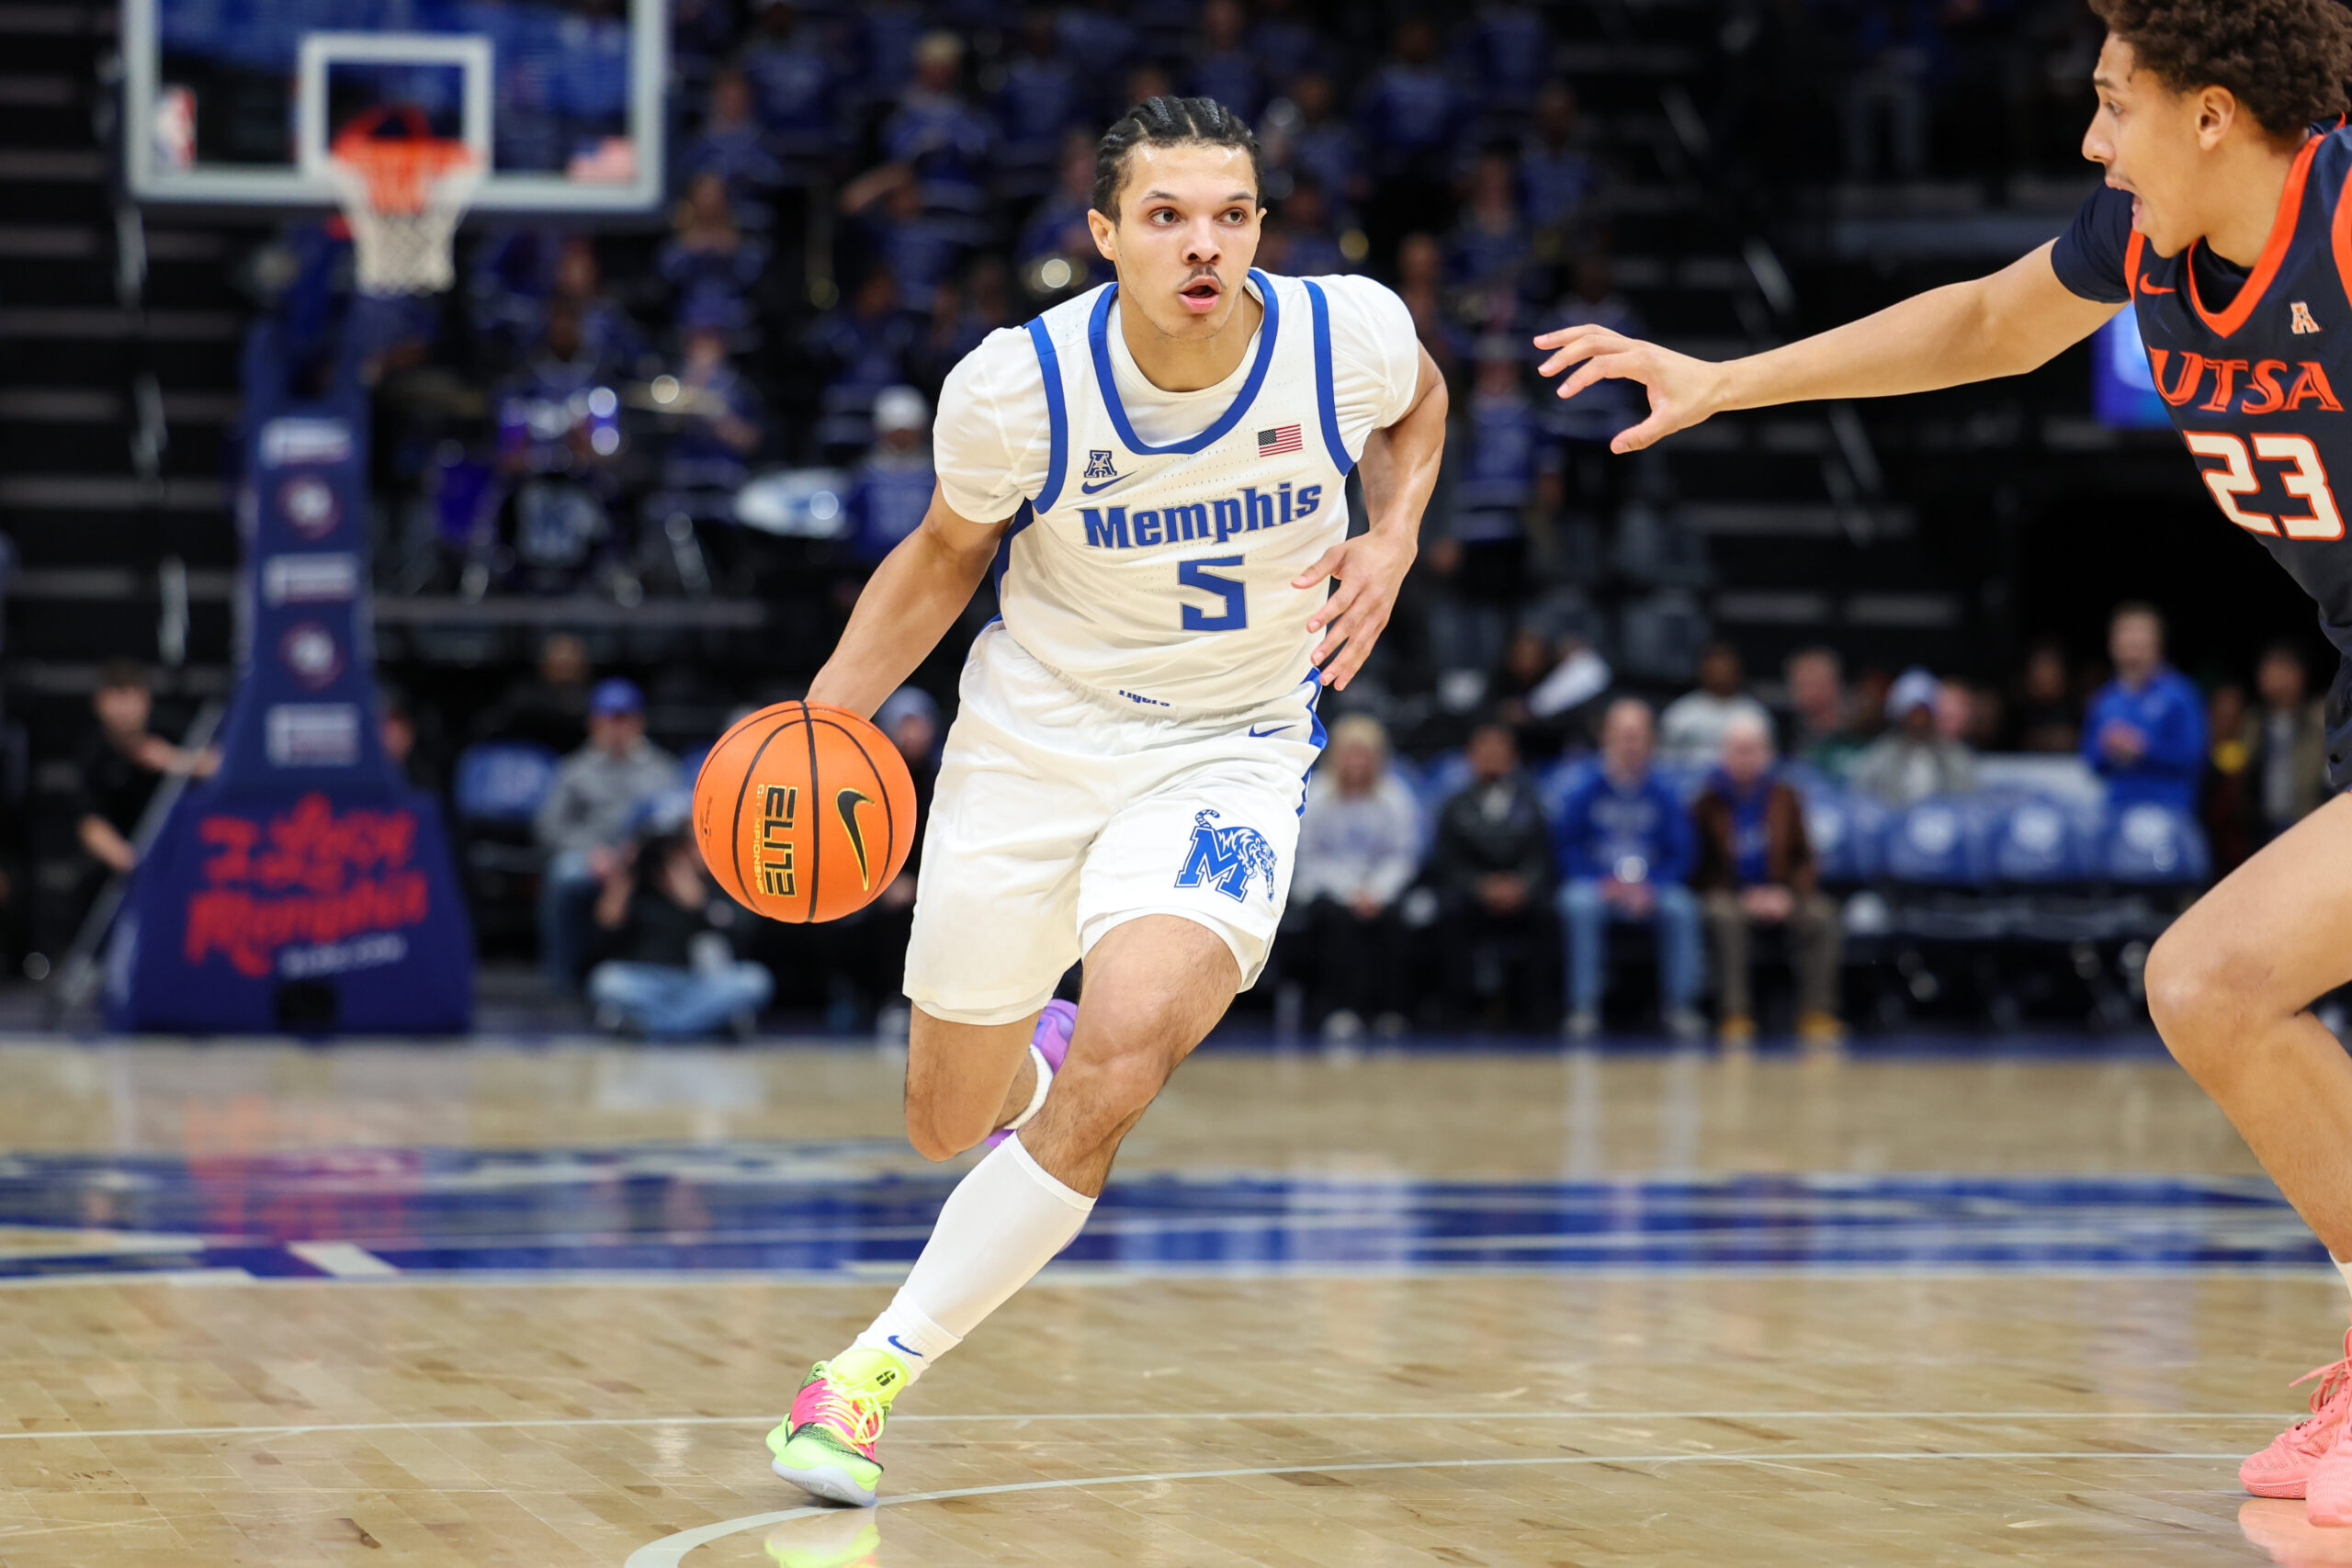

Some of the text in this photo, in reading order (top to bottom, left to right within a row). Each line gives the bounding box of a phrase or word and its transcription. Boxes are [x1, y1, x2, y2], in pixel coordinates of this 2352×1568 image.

[2148, 345, 2345, 414] UTSA
[1074, 481, 1322, 549] Memphis
[2183, 429, 2346, 540] 23
[1177, 554, 1249, 632] 5
[763, 784, 797, 897] ELITE
